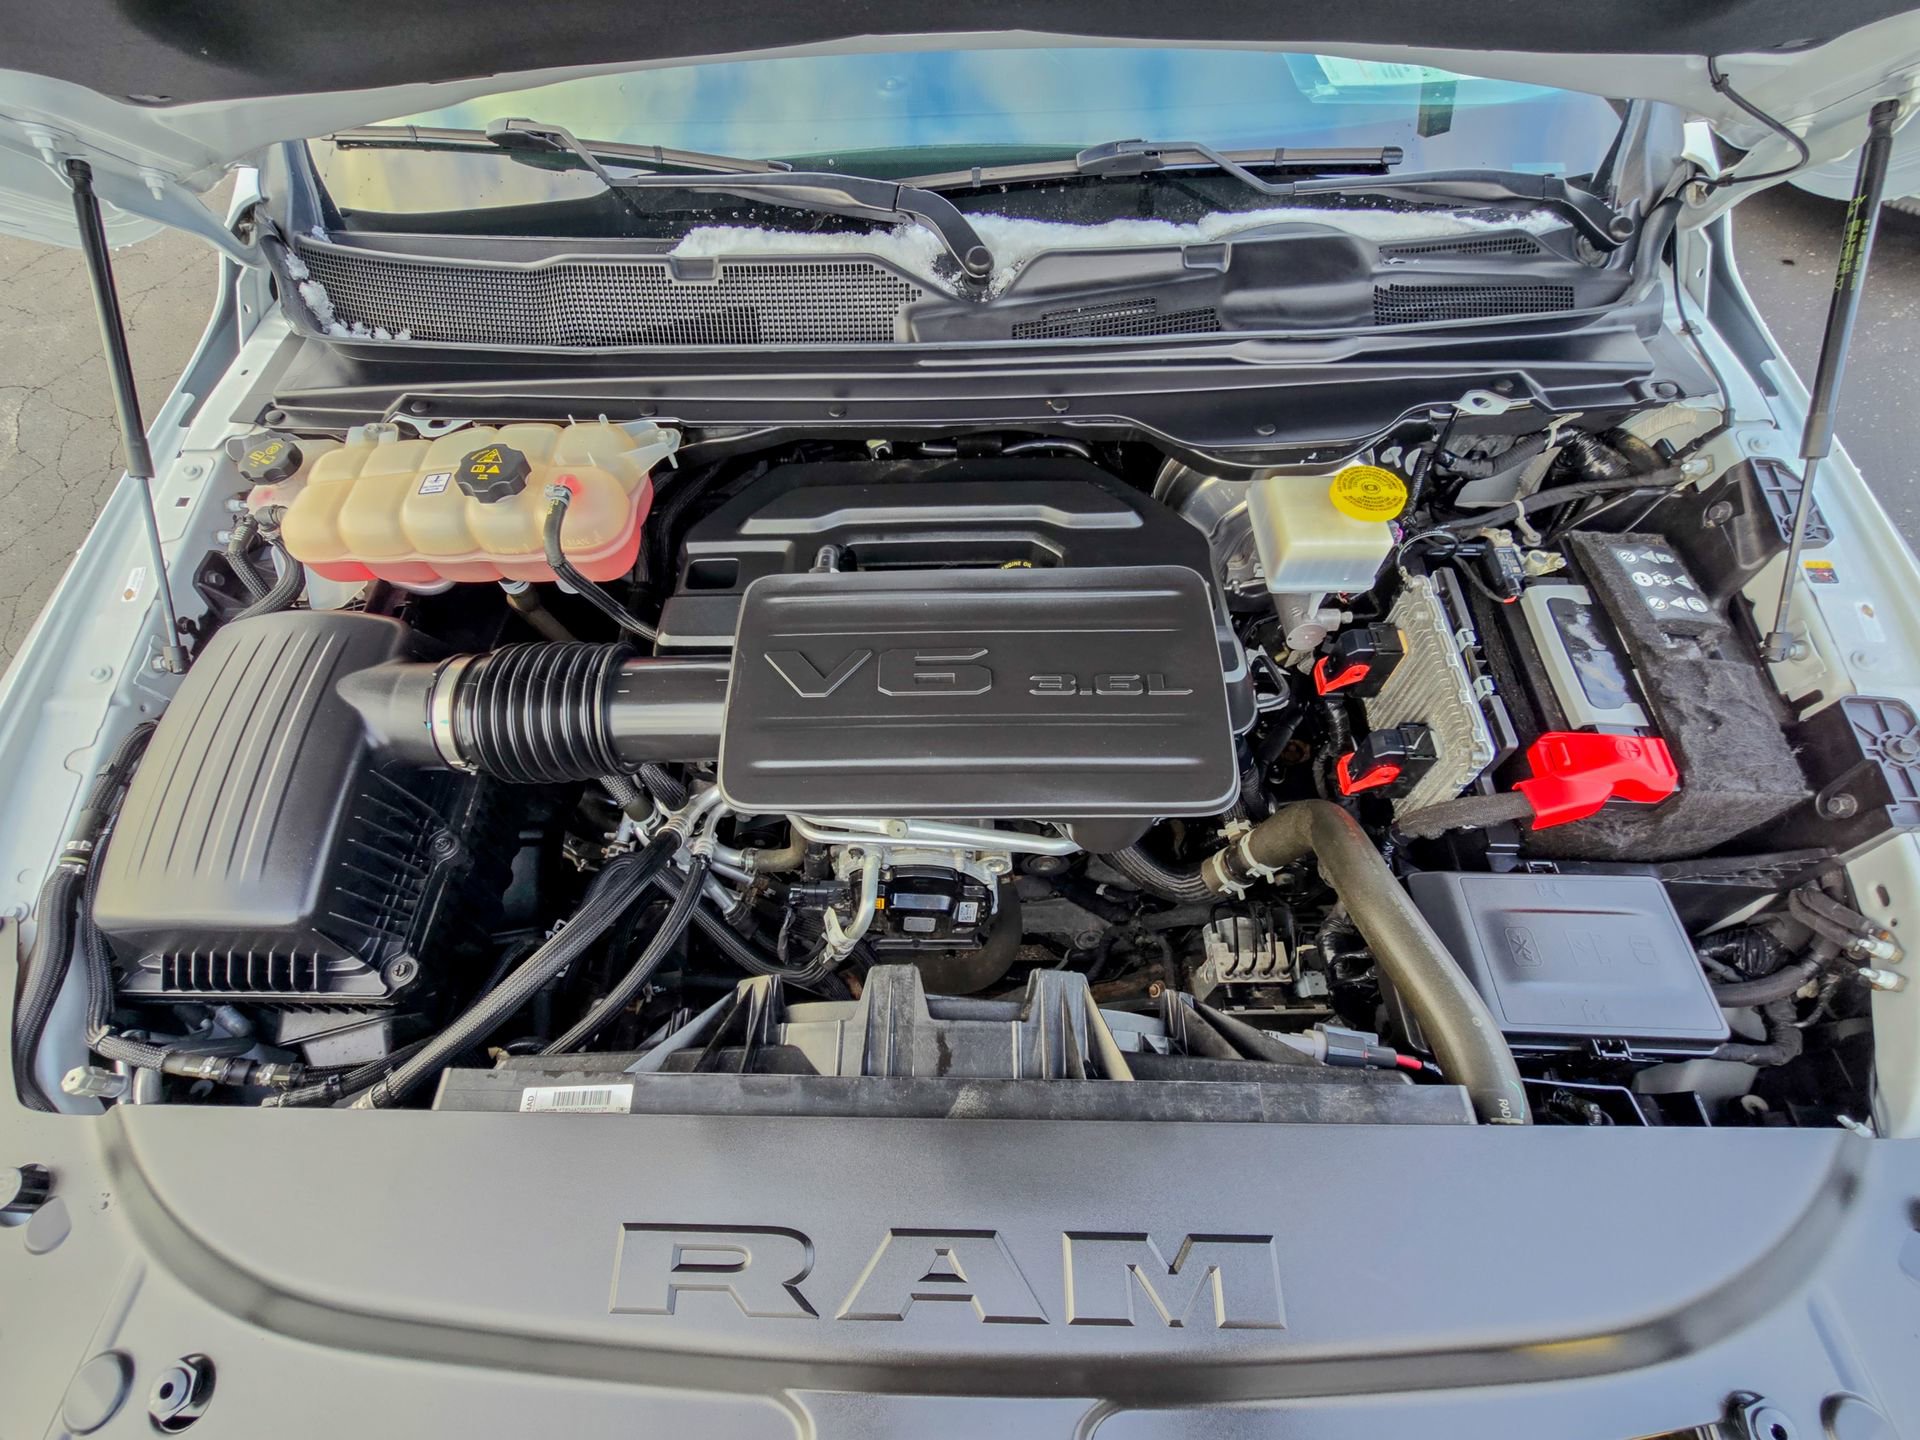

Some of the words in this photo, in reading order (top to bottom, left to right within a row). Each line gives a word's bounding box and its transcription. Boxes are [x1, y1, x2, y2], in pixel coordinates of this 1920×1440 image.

[764, 648, 992, 698] V6
[1029, 673, 1194, 696] 3.6L
[609, 1222, 1287, 1330] RAM
